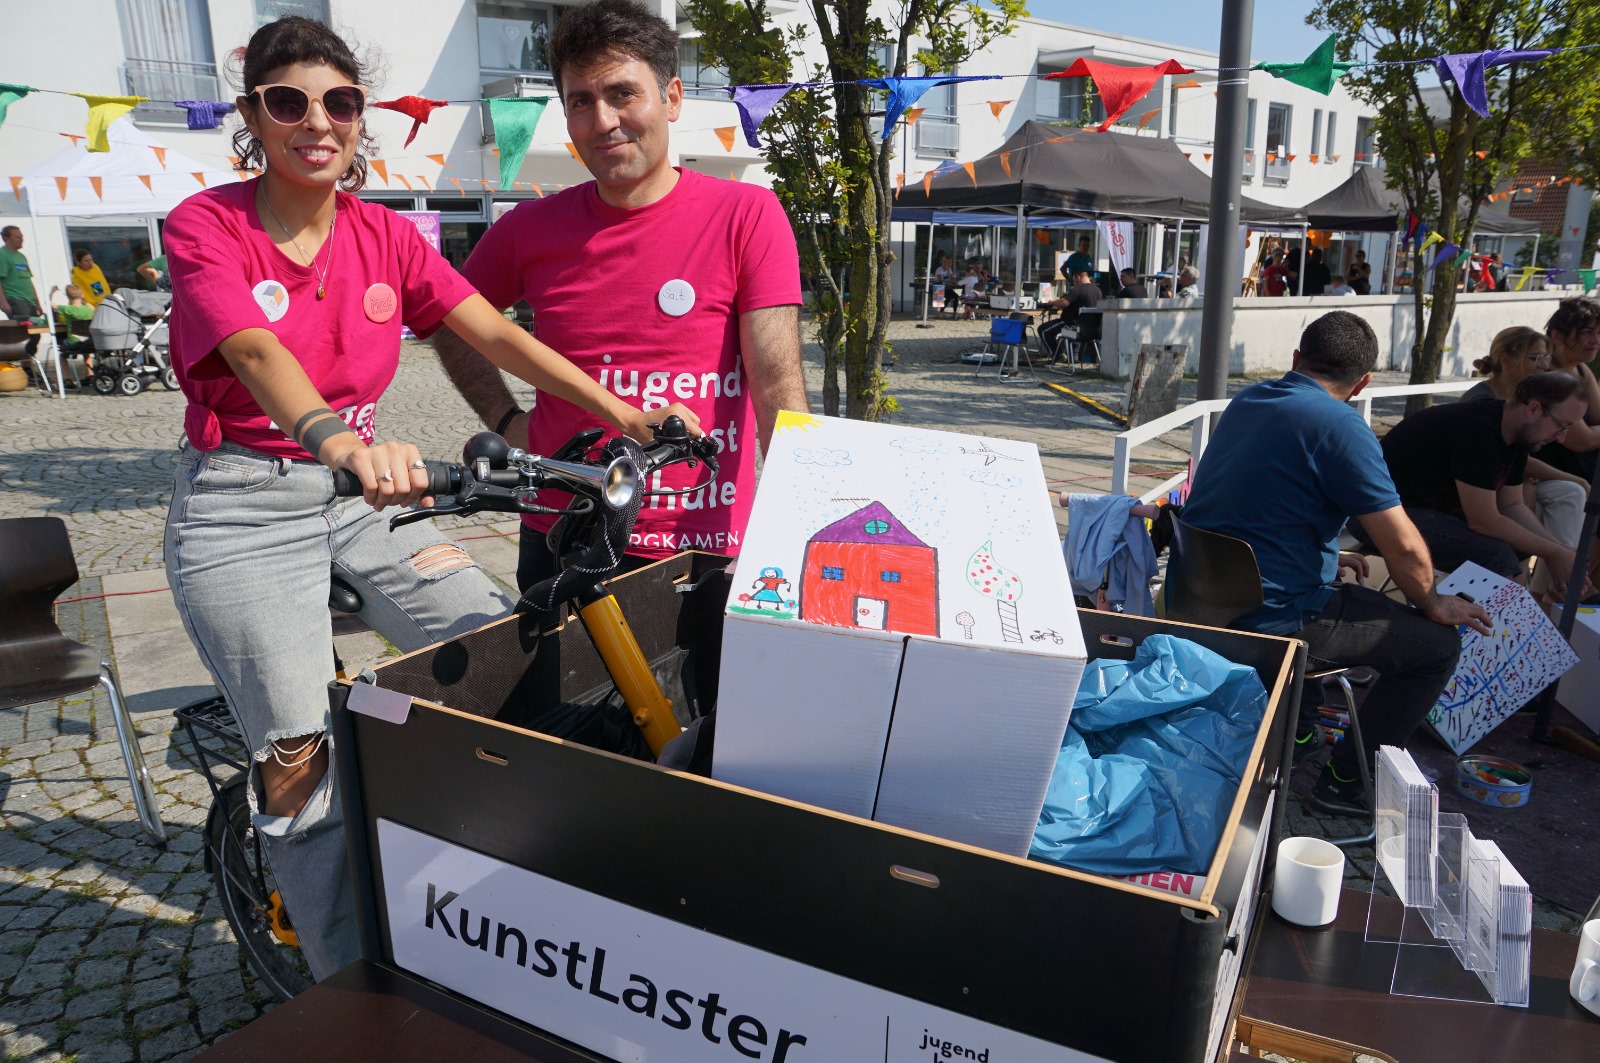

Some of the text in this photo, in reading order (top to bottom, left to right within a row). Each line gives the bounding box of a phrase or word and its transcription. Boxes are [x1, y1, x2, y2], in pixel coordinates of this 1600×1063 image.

[599, 354, 742, 413] jugend
[639, 466, 737, 511] hule
[629, 531, 739, 550] RGKAMEN
[1112, 872, 1195, 895] HEN
[425, 882, 808, 1063] KunstLaster
[918, 1028, 990, 1063] jugend
